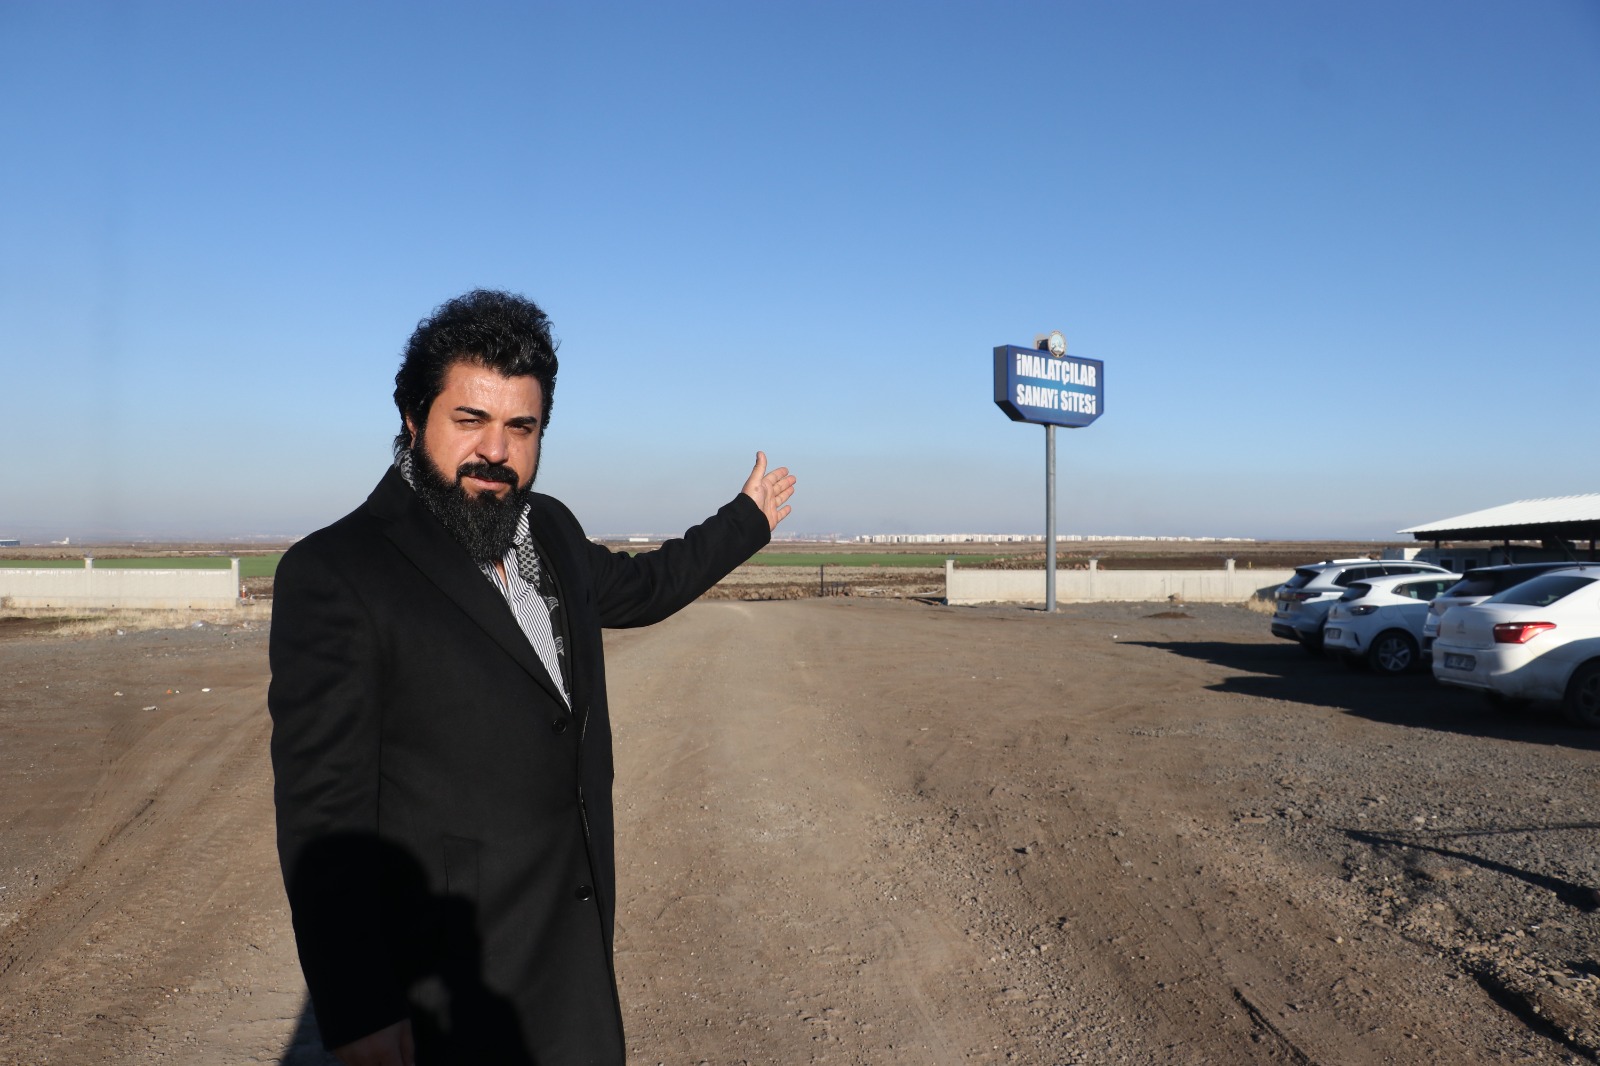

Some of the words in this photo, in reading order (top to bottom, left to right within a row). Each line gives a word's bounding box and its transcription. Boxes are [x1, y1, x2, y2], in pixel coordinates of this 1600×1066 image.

[1016, 353, 1096, 387] İMALATÇILAR
[1016, 384, 1058, 409] SANAYİ
[1060, 389, 1096, 415] SİTESİ
